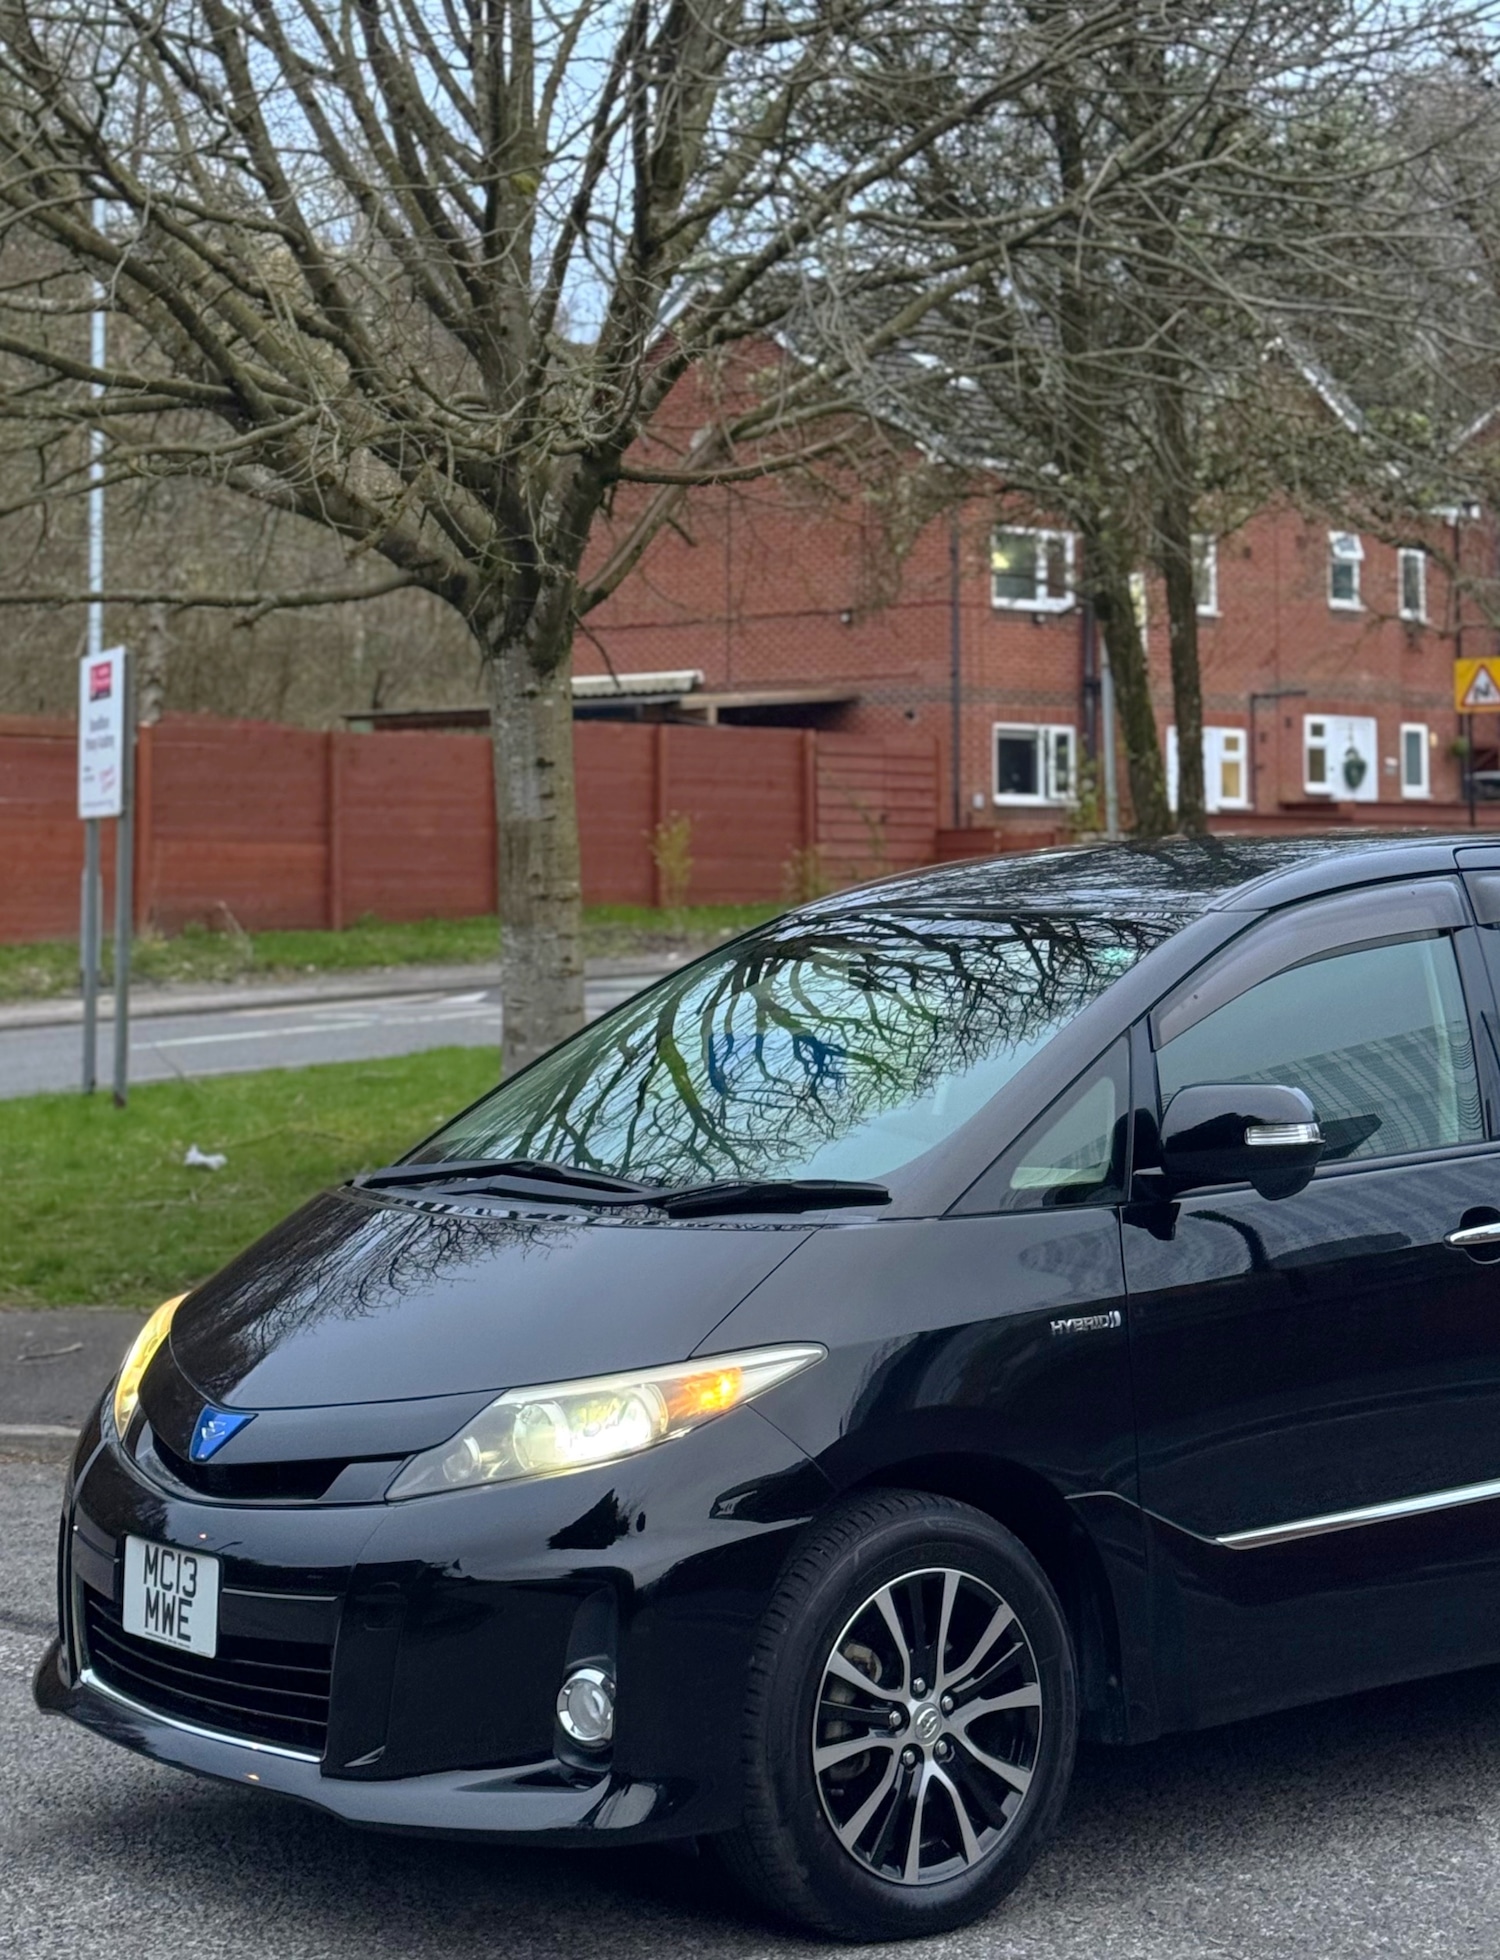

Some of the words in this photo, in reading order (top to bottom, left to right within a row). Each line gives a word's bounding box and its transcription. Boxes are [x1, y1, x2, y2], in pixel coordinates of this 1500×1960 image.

[1050, 1314, 1109, 1336] HYBRID
[143, 1543, 198, 1599] MC13
[144, 1586, 193, 1642] MWE
